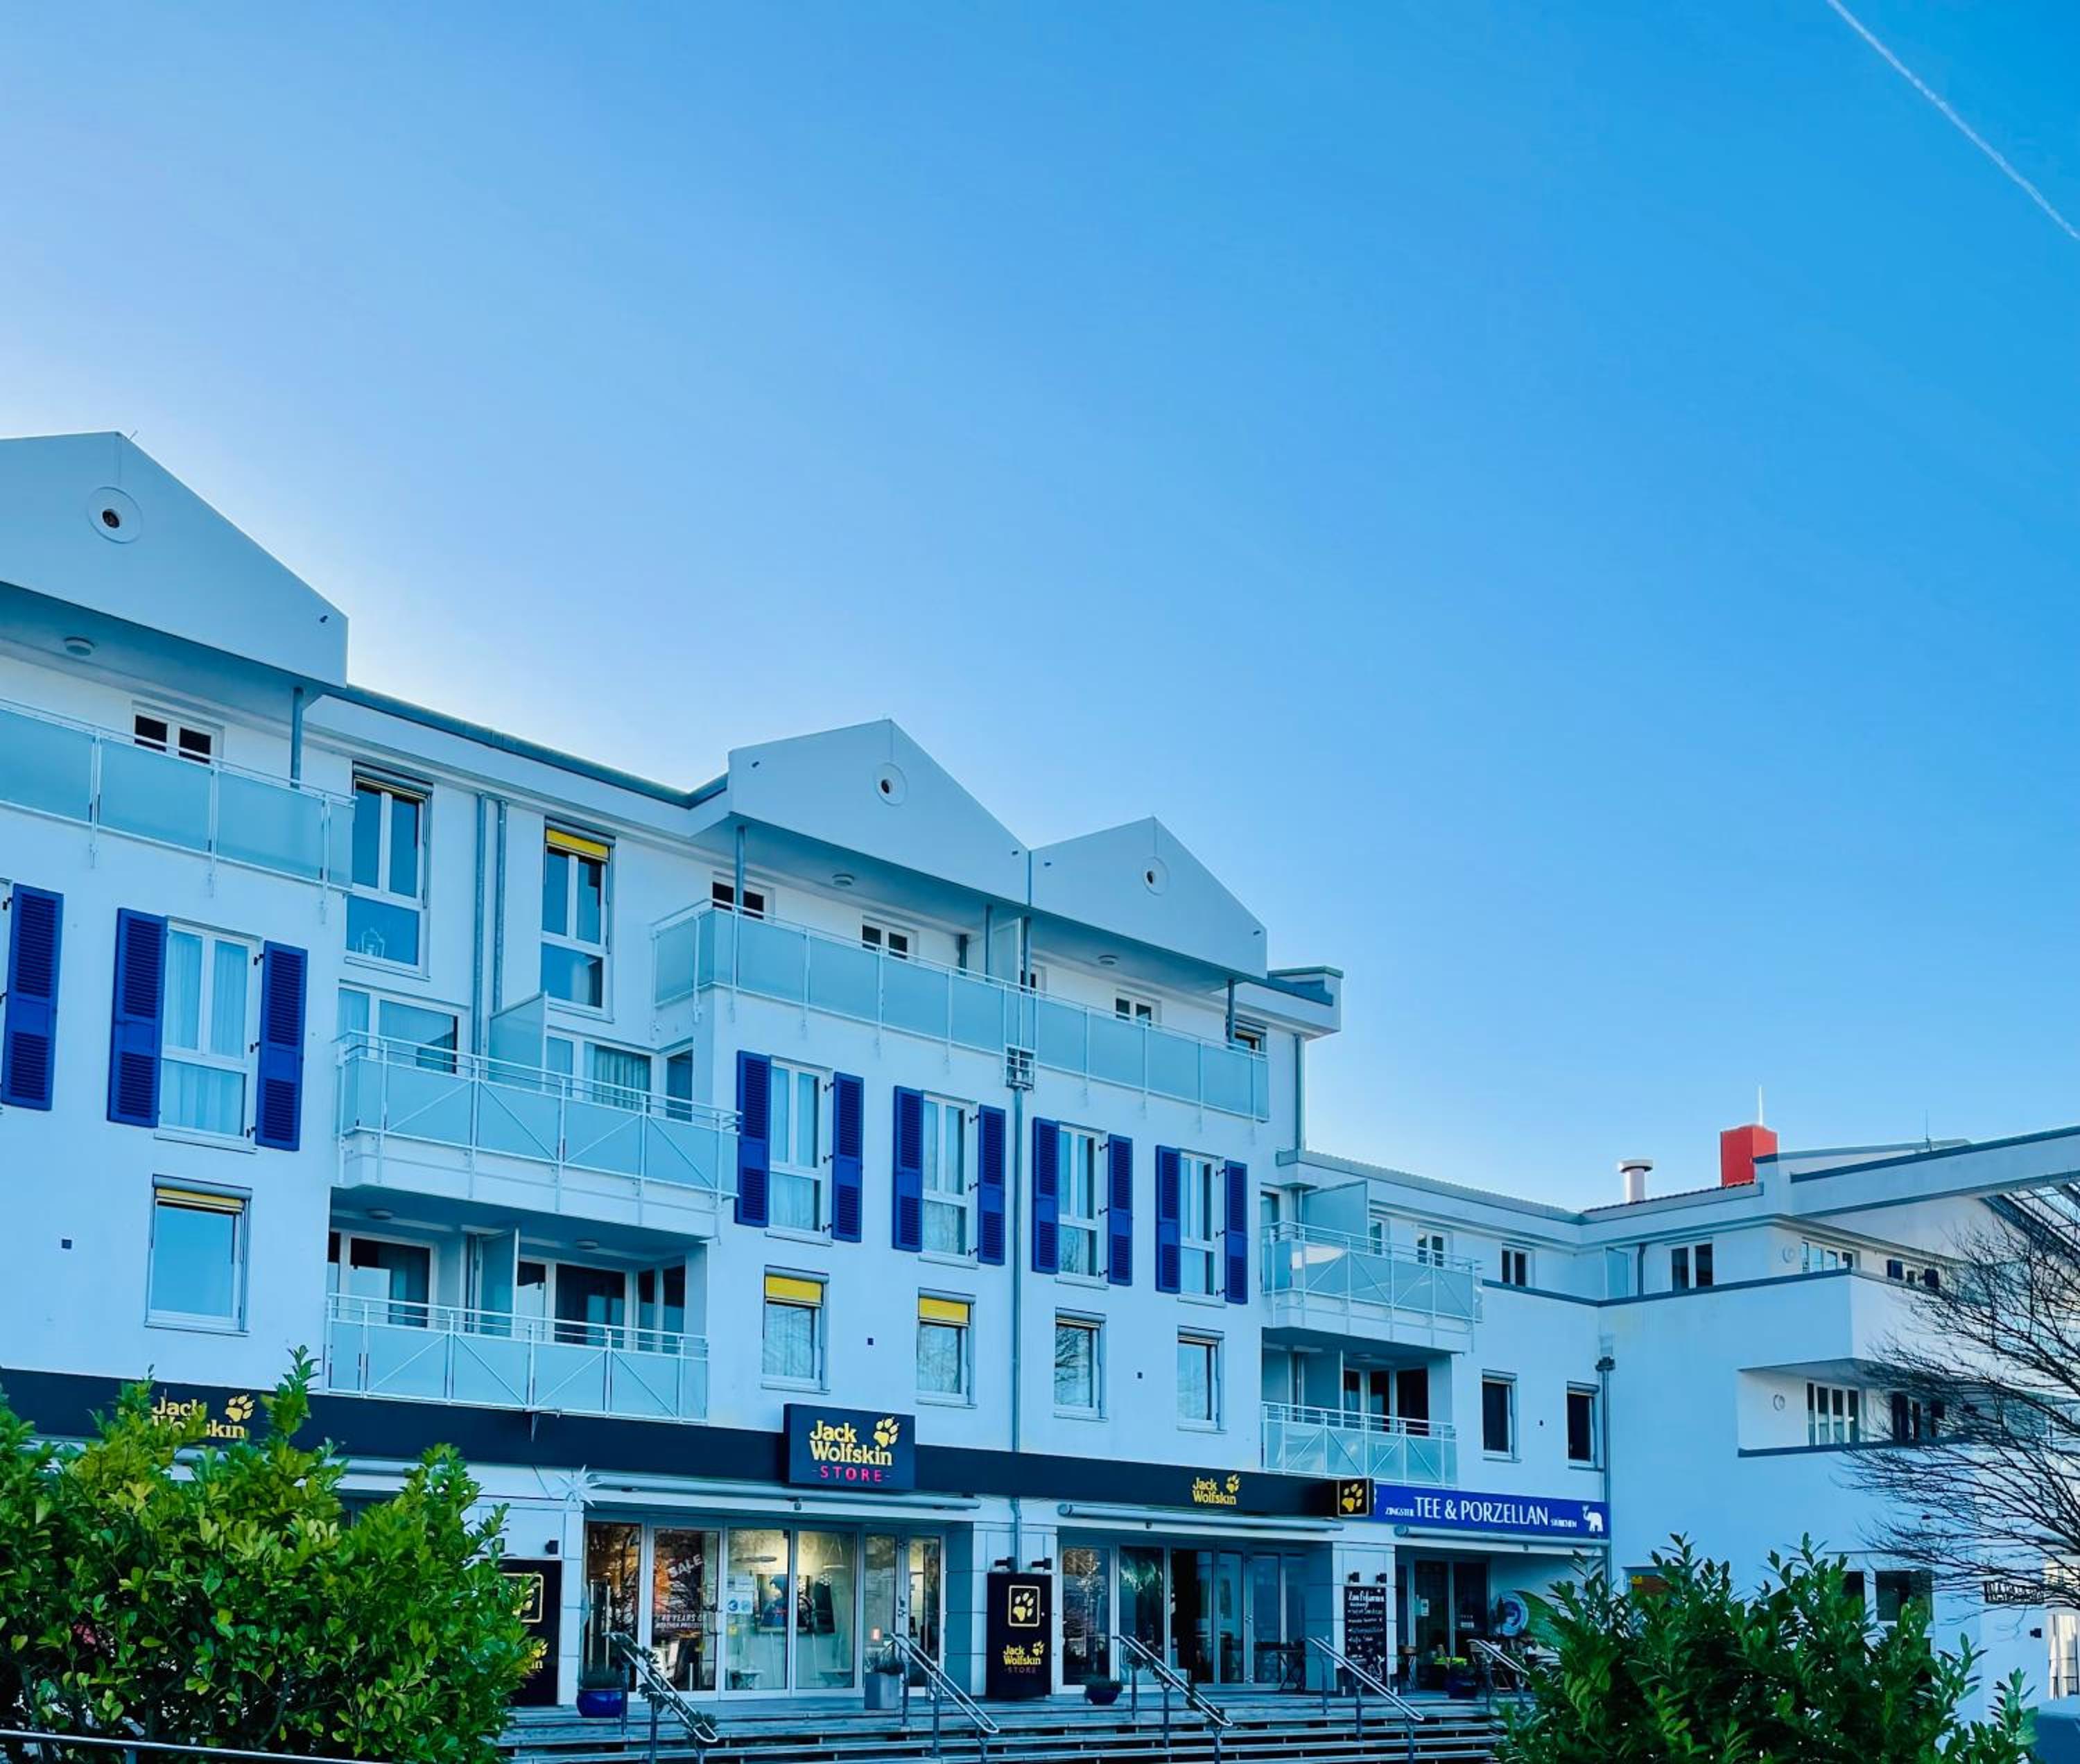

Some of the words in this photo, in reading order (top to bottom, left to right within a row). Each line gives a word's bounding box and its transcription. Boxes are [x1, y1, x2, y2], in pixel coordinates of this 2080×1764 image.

[151, 1415, 245, 1438] skin
[809, 1420, 858, 1443] Jack
[809, 1439, 892, 1467] Wolfskin
[820, 1465, 883, 1482] STORE
[1192, 1476, 1217, 1491] Jack
[1192, 1489, 1237, 1505] Wolfskin
[1414, 1496, 1441, 1519] TEE
[1444, 1499, 1458, 1521] &
[1461, 1500, 1549, 1526] PORZELLAN
[668, 1553, 704, 1578] SALE
[673, 1613, 696, 1622] YEARS
[1003, 1644, 1025, 1655] Jack
[1003, 1654, 1041, 1665] Wolfskin
